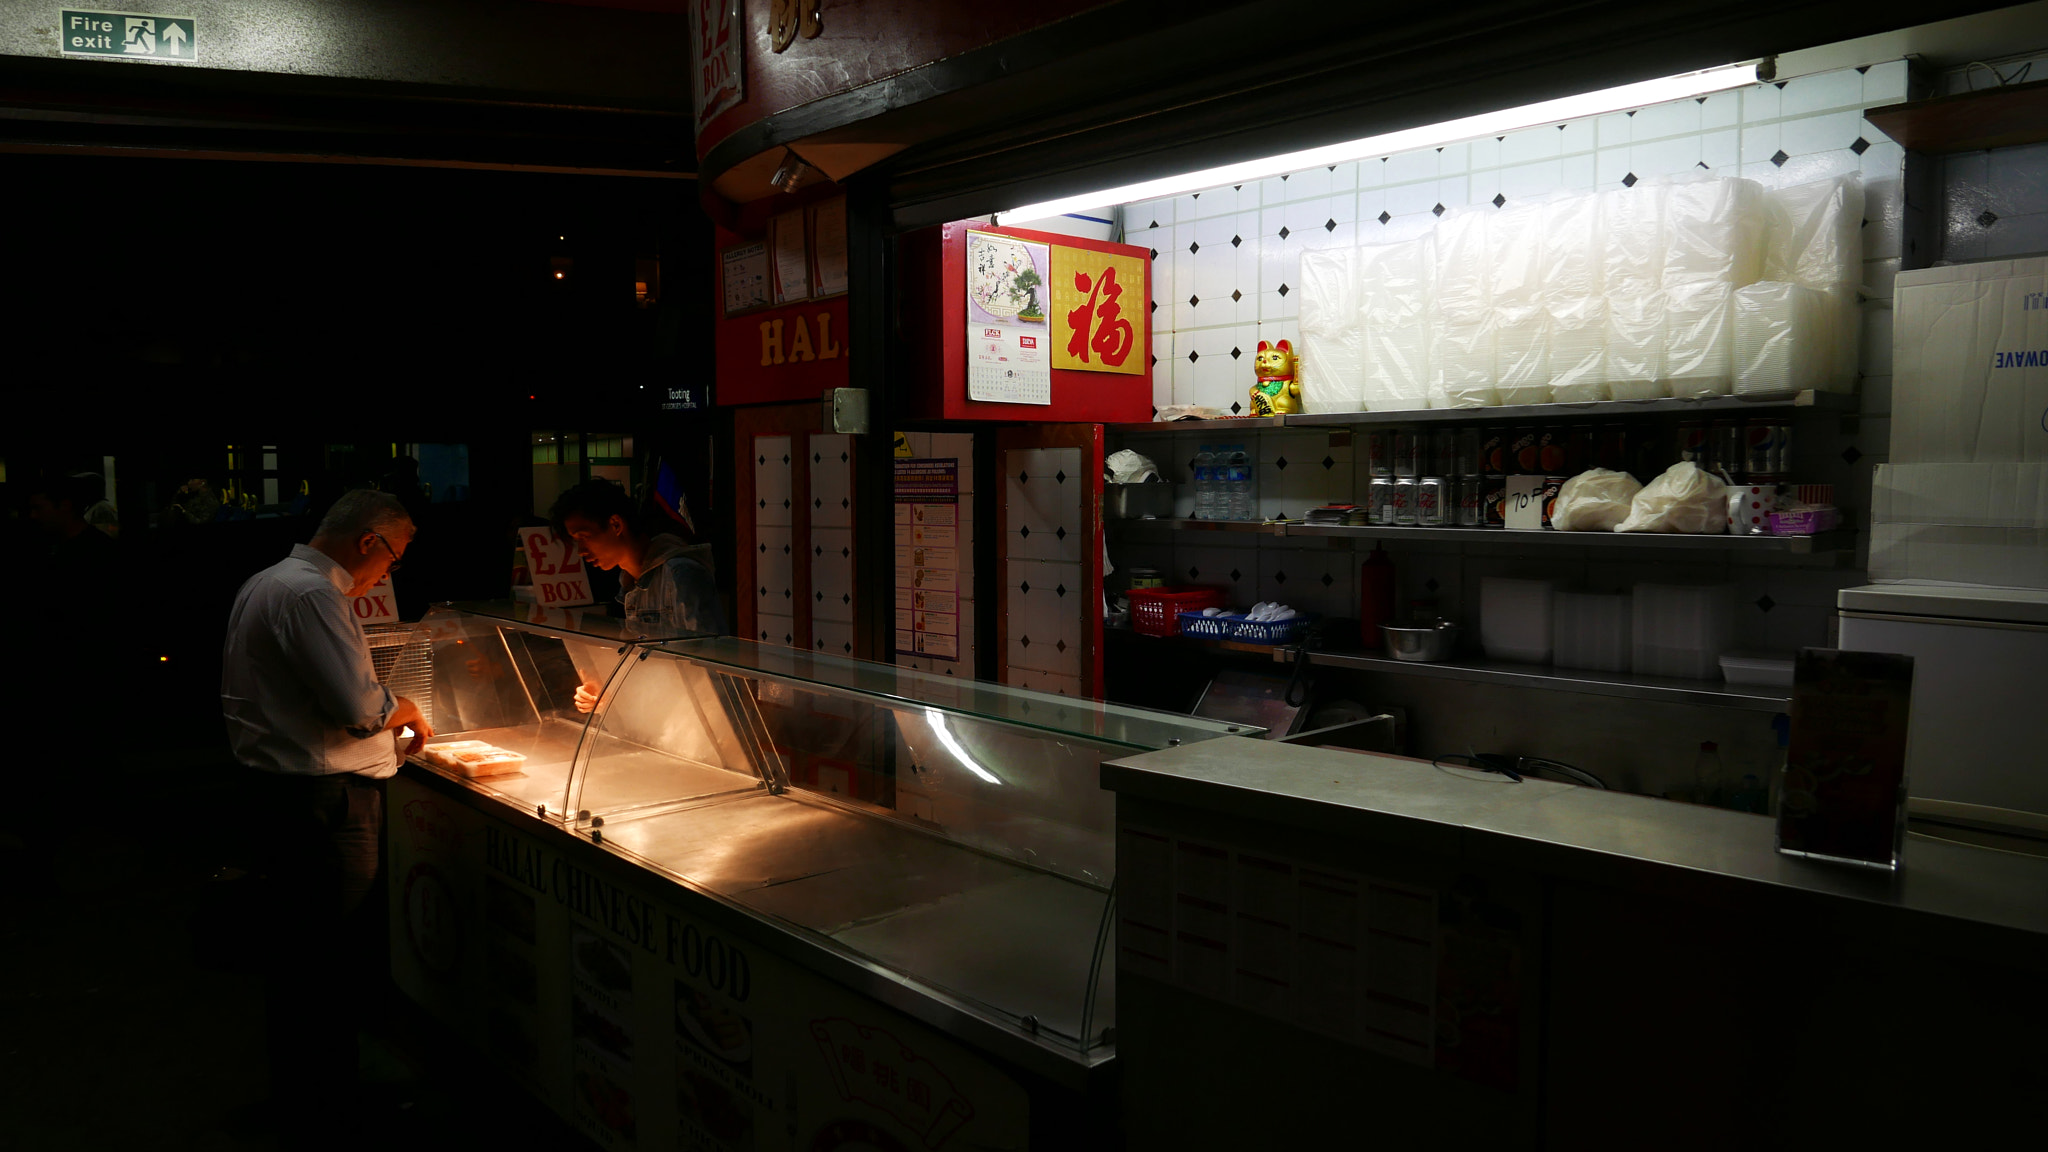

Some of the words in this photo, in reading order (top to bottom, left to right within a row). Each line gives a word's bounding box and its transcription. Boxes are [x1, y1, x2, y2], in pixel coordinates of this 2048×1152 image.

[71, 16, 113, 32] Fire
[71, 35, 112, 49] exit
[703, 47, 730, 97] BOX
[1067, 266, 1133, 366] 福
[759, 312, 849, 367] HAL
[667, 387, 691, 403] Tooting
[528, 533, 581, 575] £2
[353, 595, 390, 619] OX
[541, 580, 587, 603] BOX
[486, 825, 547, 895] HALAL
[552, 856, 658, 954] CHINESE
[665, 914, 751, 1002] FOOD
[675, 1038, 731, 1084] SPRING
[734, 1075, 778, 1112] ROLL
